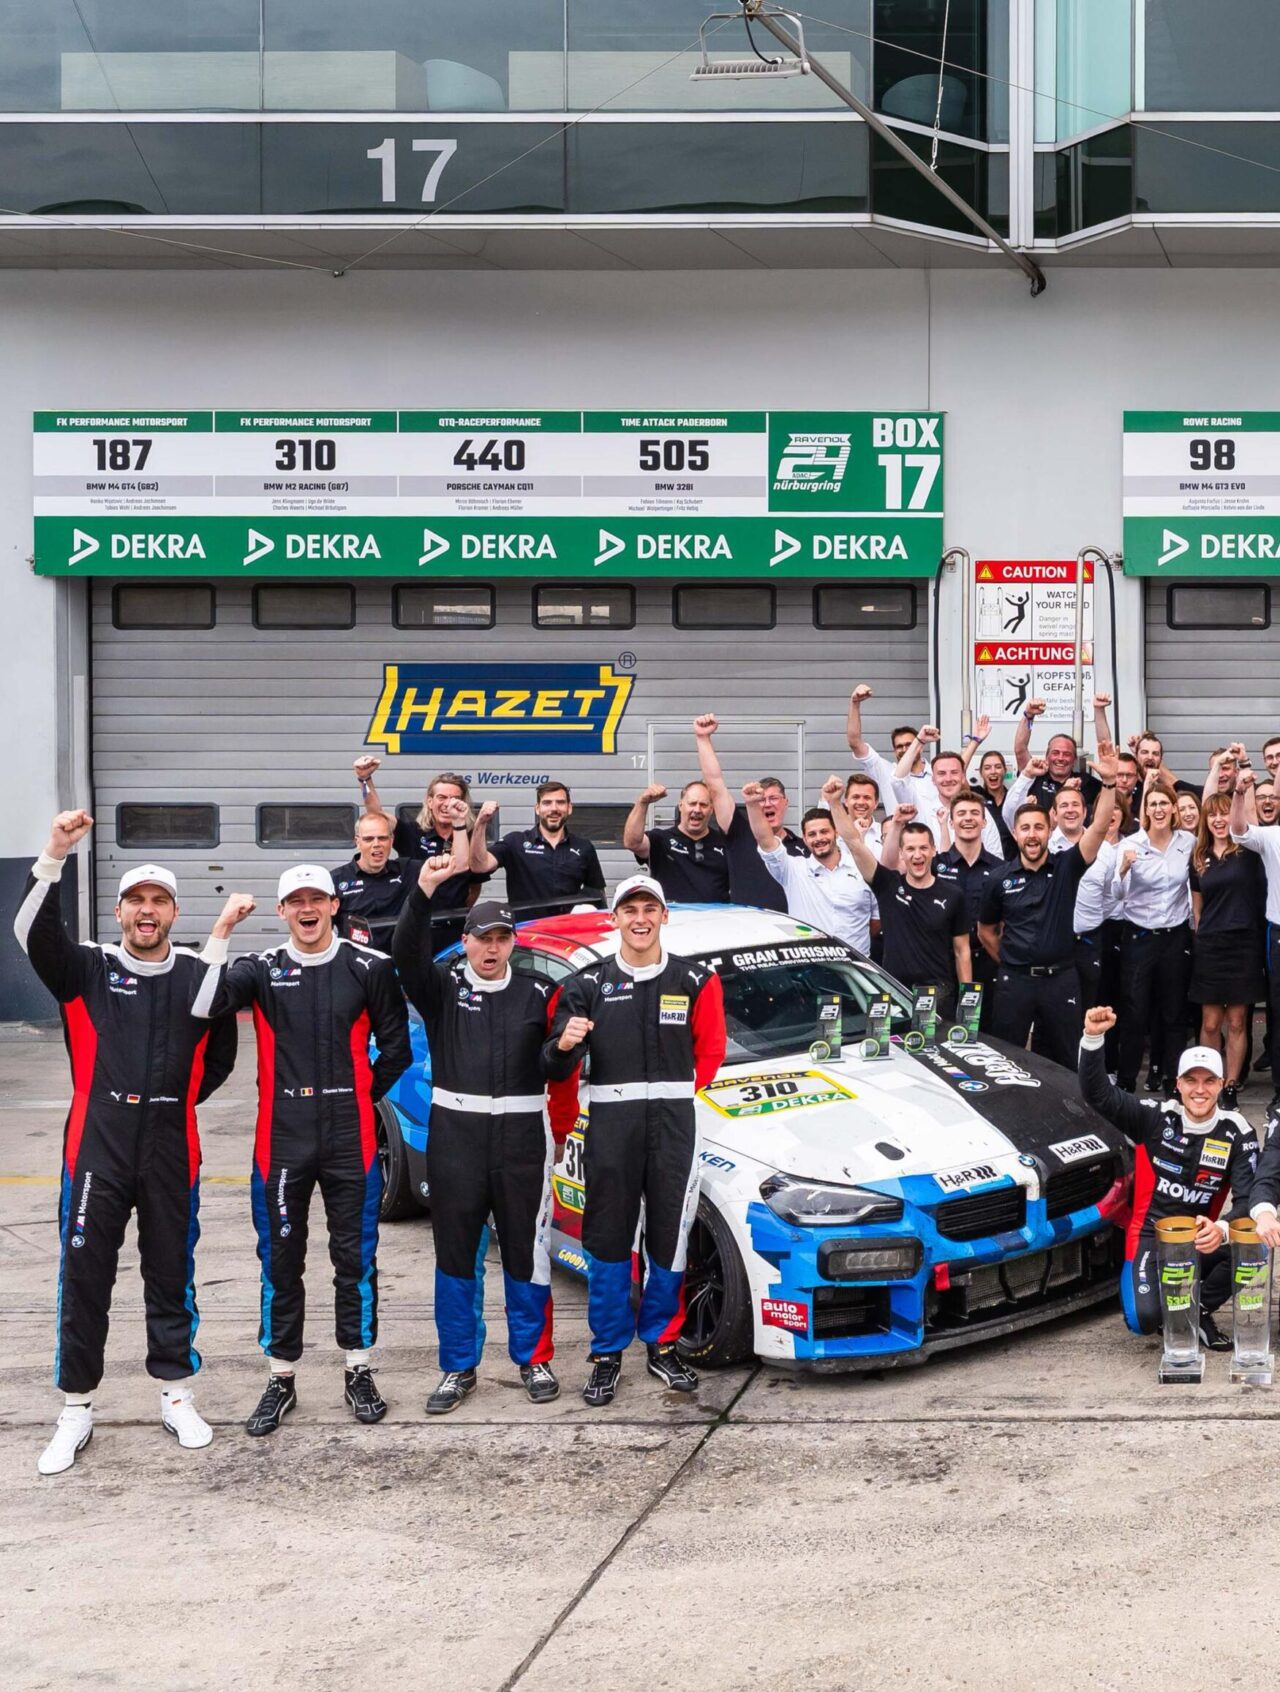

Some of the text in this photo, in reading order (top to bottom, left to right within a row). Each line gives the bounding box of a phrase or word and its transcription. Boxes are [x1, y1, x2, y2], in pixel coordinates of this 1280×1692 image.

[366, 138, 458, 203] 17
[56, 417, 188, 427] FK PERFORMANCE MOTORSPORT
[240, 417, 372, 427] FK PERFORMANCE MOTORSPORT
[620, 417, 728, 427] TIME ATTACK PADERBORN
[1182, 417, 1243, 427] ROWE RACING
[872, 417, 941, 448] BOX
[92, 438, 153, 471] 187
[275, 438, 336, 471] 310
[453, 439, 526, 472] 440
[639, 439, 710, 472] 505
[776, 445, 852, 480] 24
[1189, 438, 1236, 471] 98
[86, 481, 159, 492] BMW M4 GT4 (G82)
[263, 481, 349, 492] BMW M2 RACING (G87)
[446, 482, 482, 491] PORSCHE
[482, 482, 516, 491] CAYMAN
[654, 482, 675, 491] BMW
[773, 479, 842, 493] nürburgring
[877, 454, 941, 510] 17
[1179, 482, 1246, 491] BMW M4 GT3 EVO
[111, 533, 207, 559] DEKRA
[286, 533, 382, 559] DEKRA
[461, 533, 558, 559] DEKRA
[637, 533, 734, 560] DEKRA
[812, 534, 909, 560] DEKRA
[1002, 566, 1067, 579] CAUTION
[1036, 601, 1090, 609] YOUR HED
[995, 647, 1074, 661] ACHTUNG
[1037, 671, 1092, 680] KOPFSTß
[395, 687, 607, 731] HAZET
[631, 755, 646, 769] 17
[732, 945, 848, 967] GRAN TURISMO
[738, 1082, 800, 1103] 310
[771, 1091, 850, 1110] DEKRA
[77, 1171, 93, 1213] Motorsport
[1156, 1176, 1213, 1204] ROWE
[763, 1301, 797, 1314] auto
[770, 1312, 804, 1322] motor
[783, 1319, 807, 1329] sport
